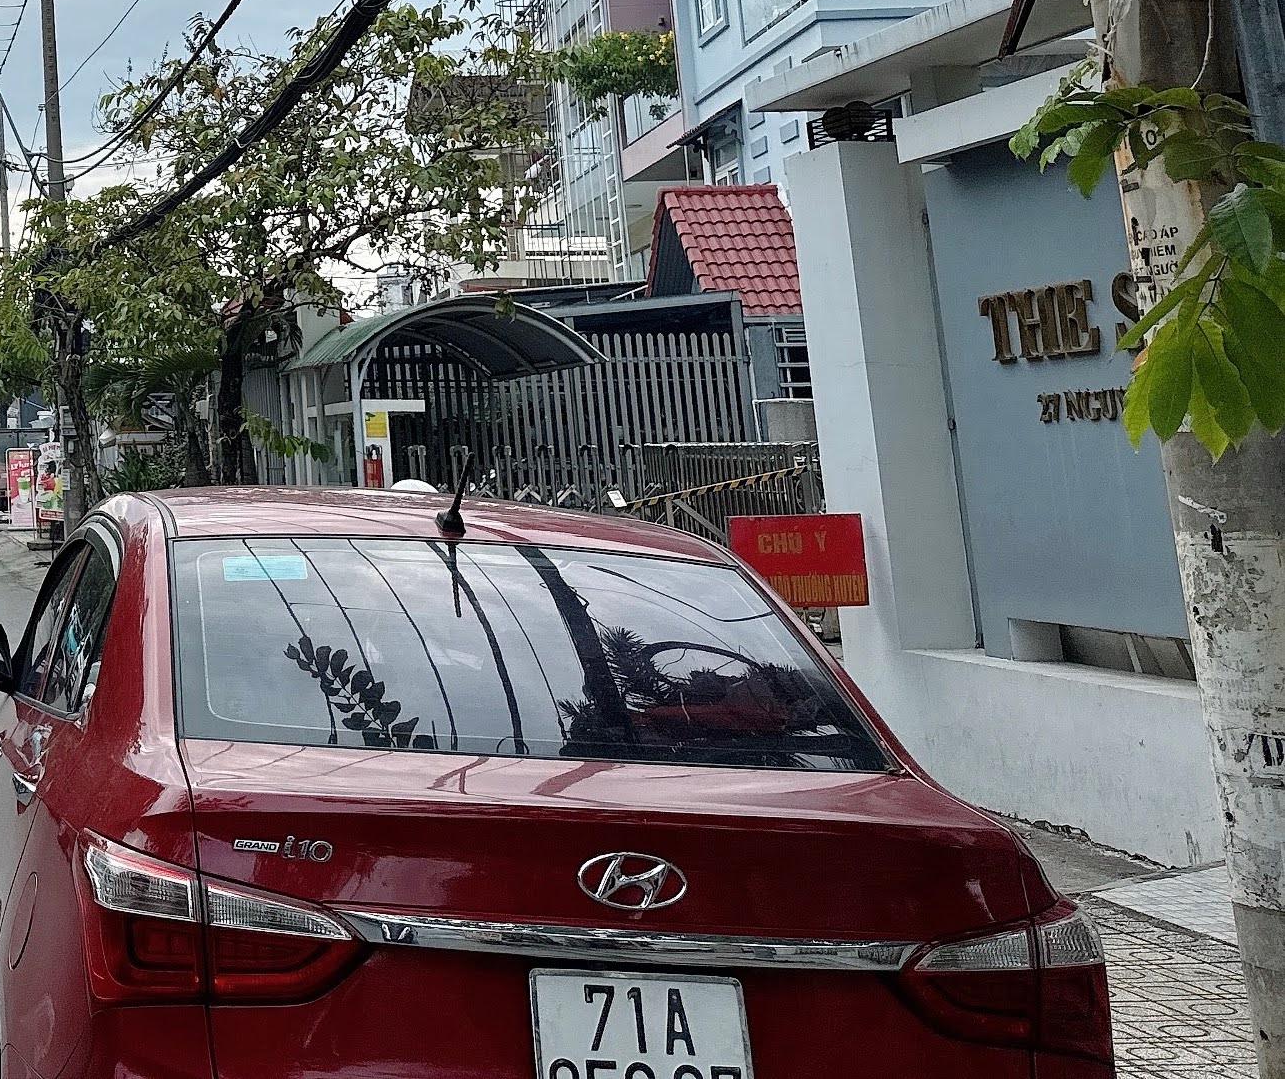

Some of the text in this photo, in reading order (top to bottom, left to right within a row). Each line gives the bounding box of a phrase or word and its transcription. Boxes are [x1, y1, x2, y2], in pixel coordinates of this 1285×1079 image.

[978, 279, 1101, 364] THE
[234, 835, 333, 863] GRAND i10
[583, 984, 696, 1056] 71A
